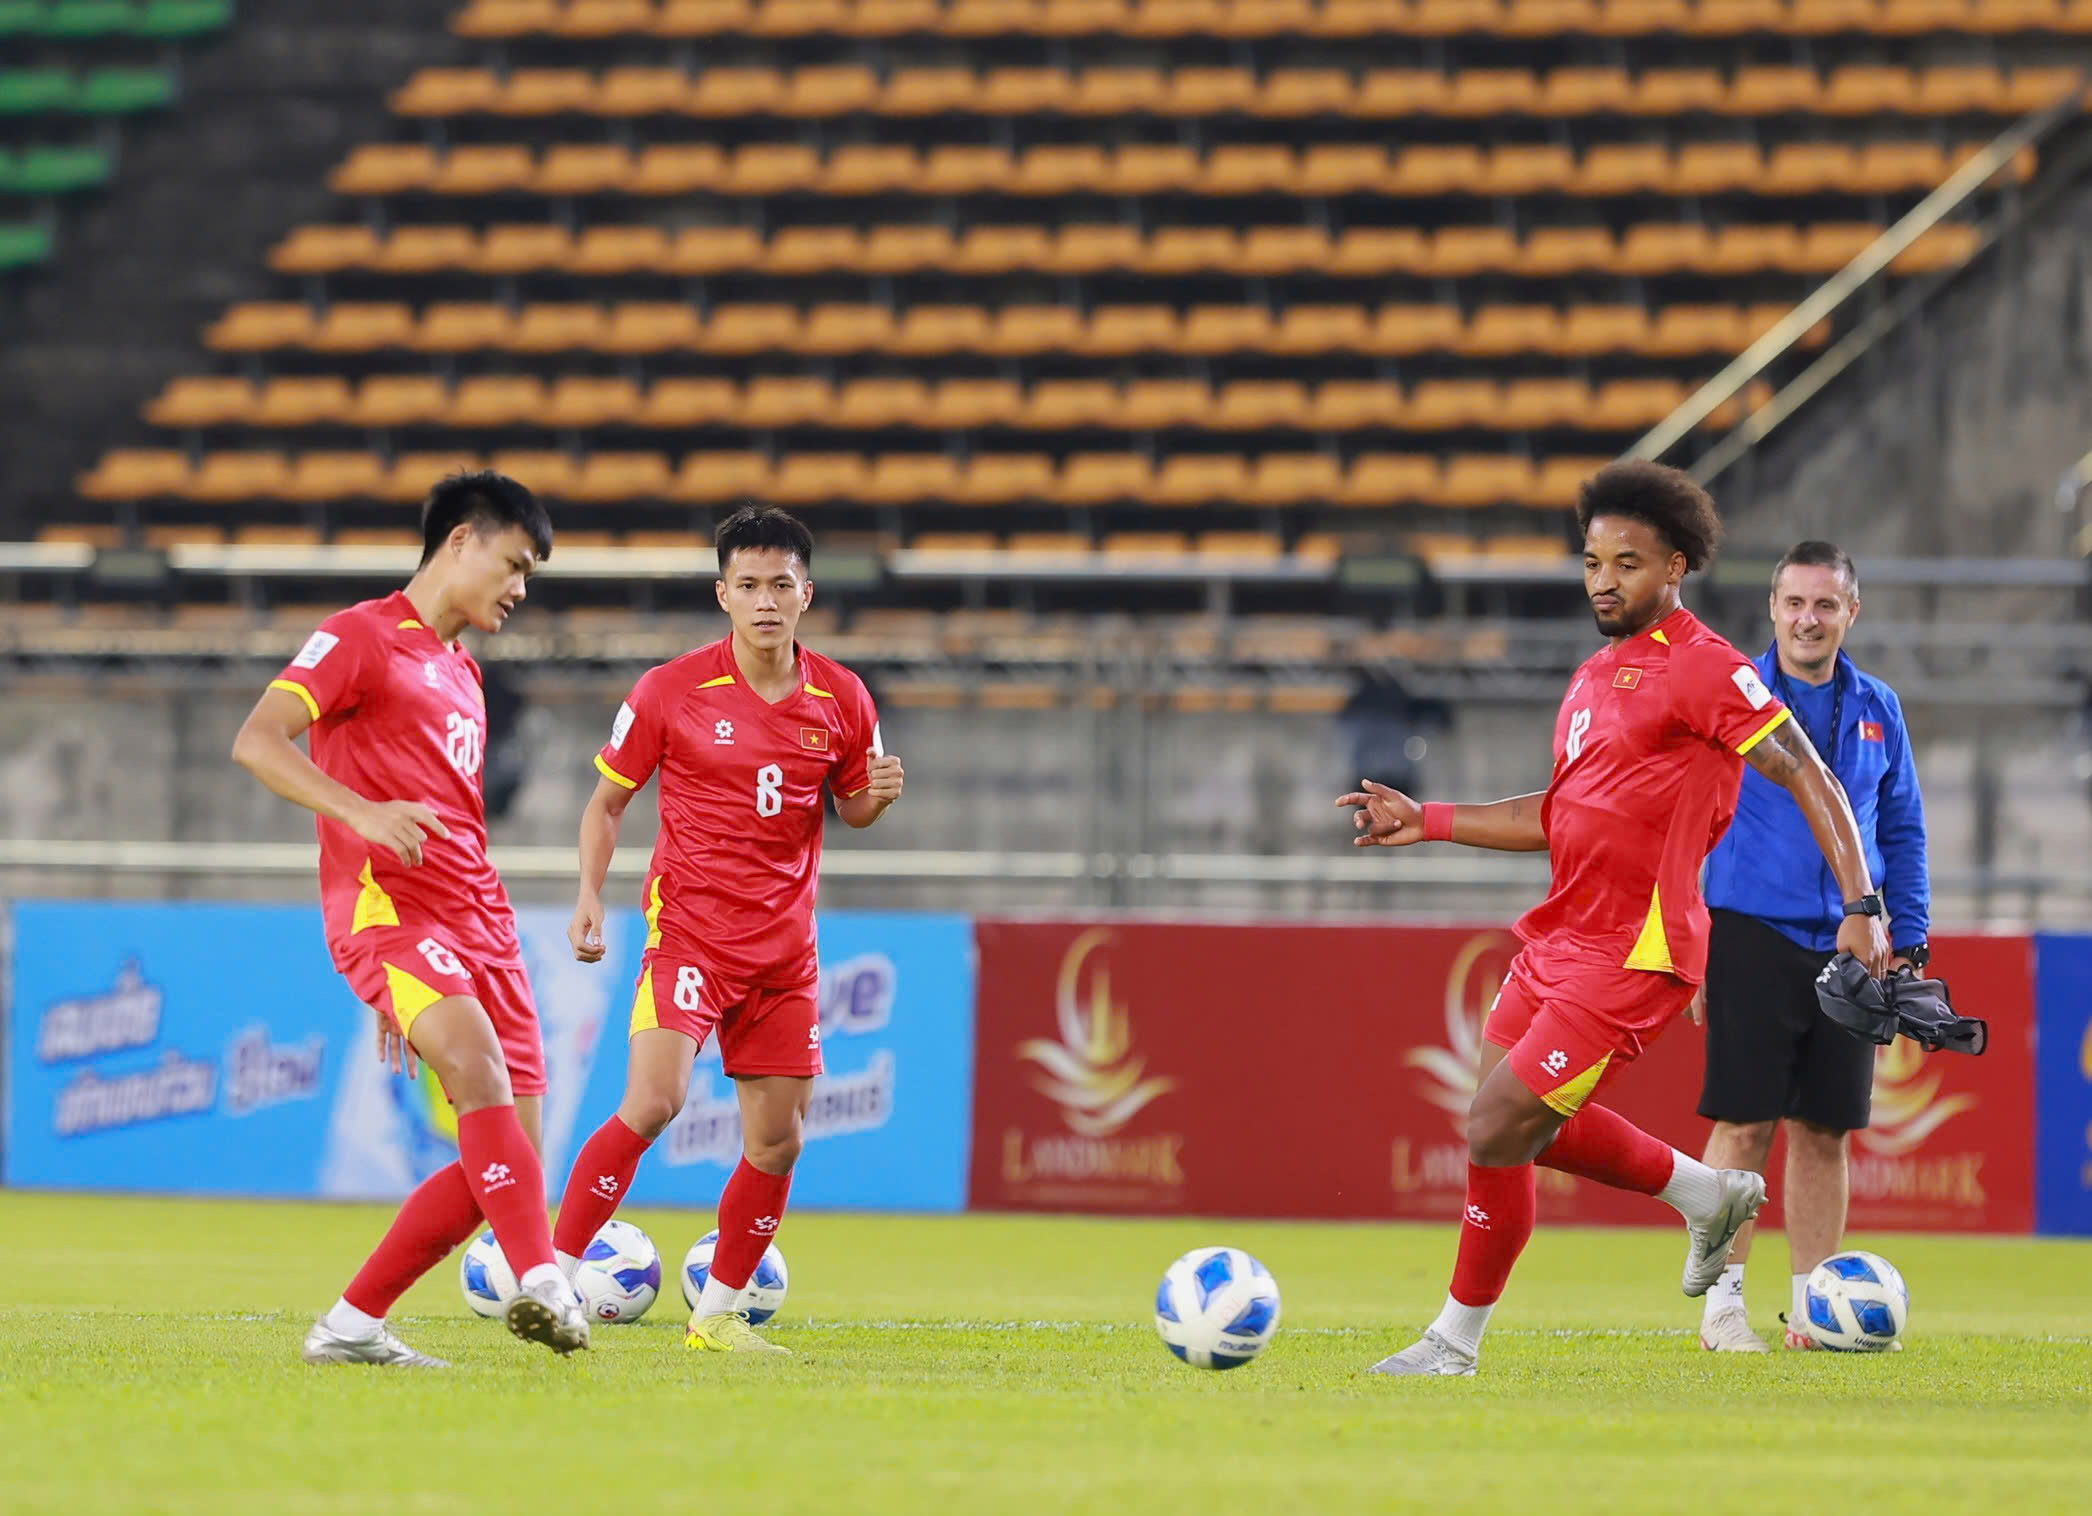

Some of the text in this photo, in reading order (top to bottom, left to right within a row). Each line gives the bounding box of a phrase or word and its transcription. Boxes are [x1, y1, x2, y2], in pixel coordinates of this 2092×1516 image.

[446, 711, 480, 777] 20
[1566, 707, 1591, 766] 12
[756, 763, 783, 817] 8
[673, 966, 703, 1011] 8
